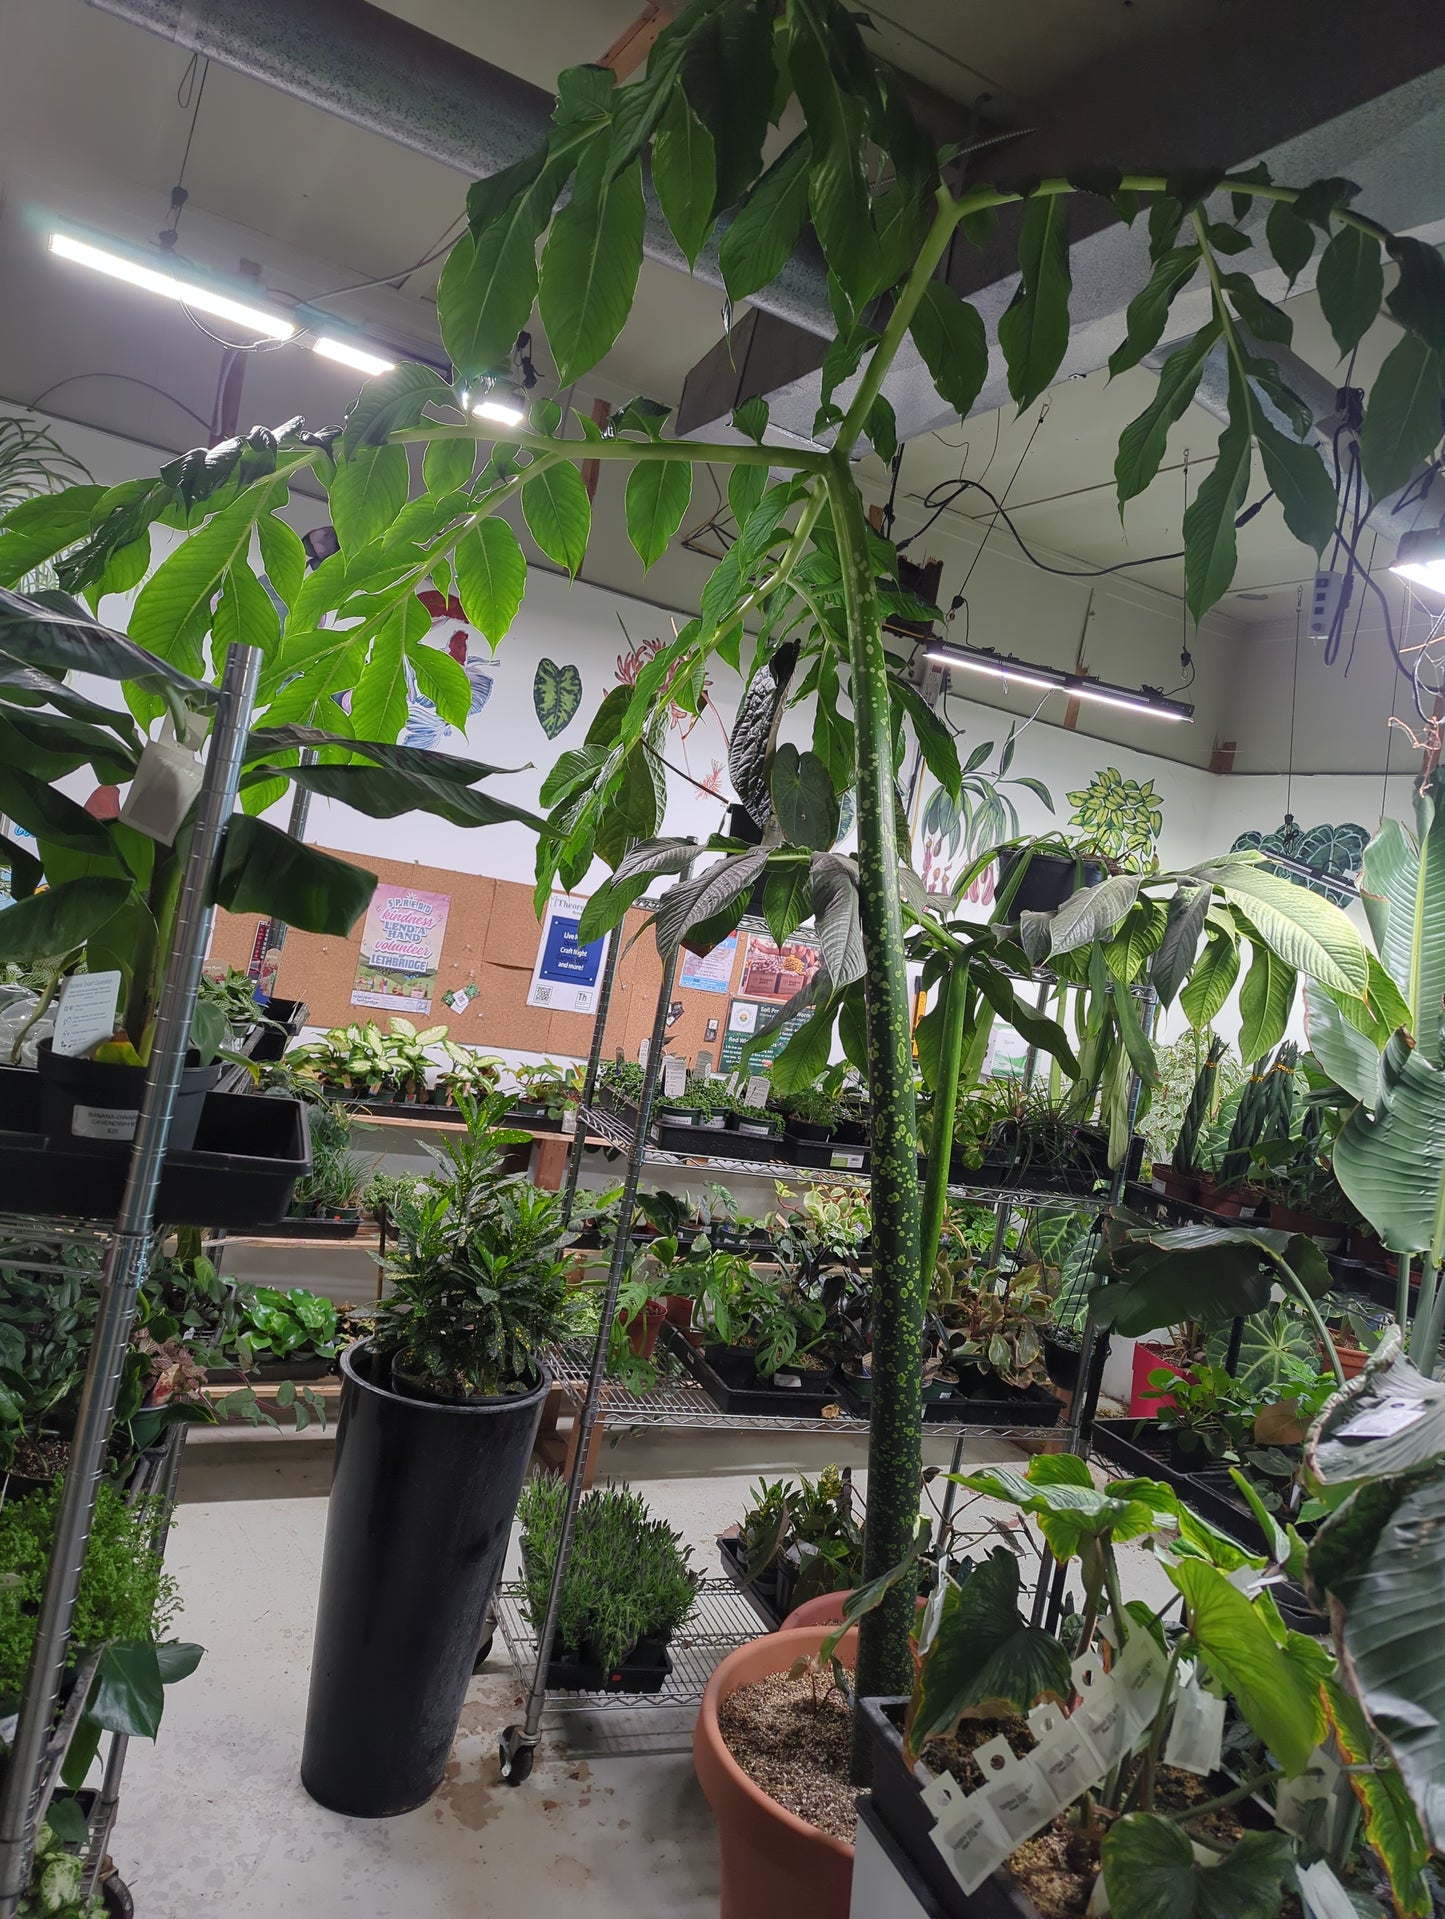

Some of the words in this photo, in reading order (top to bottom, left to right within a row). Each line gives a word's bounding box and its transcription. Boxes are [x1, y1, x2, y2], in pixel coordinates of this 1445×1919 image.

[388, 899, 431, 914] SPREAD
[383, 909, 433, 927] kindness
[385, 921, 415, 934] LEND
[416, 927, 426, 935] A
[388, 931, 421, 942] HAND
[563, 932, 575, 940] Live
[375, 940, 430, 957] volunteer
[560, 946, 573, 955] Craft
[572, 948, 588, 958] Night
[371, 954, 426, 971] LETHBRIDGE
[558, 961, 569, 969] and
[568, 963, 584, 971] more!
[578, 992, 587, 1001] Th
